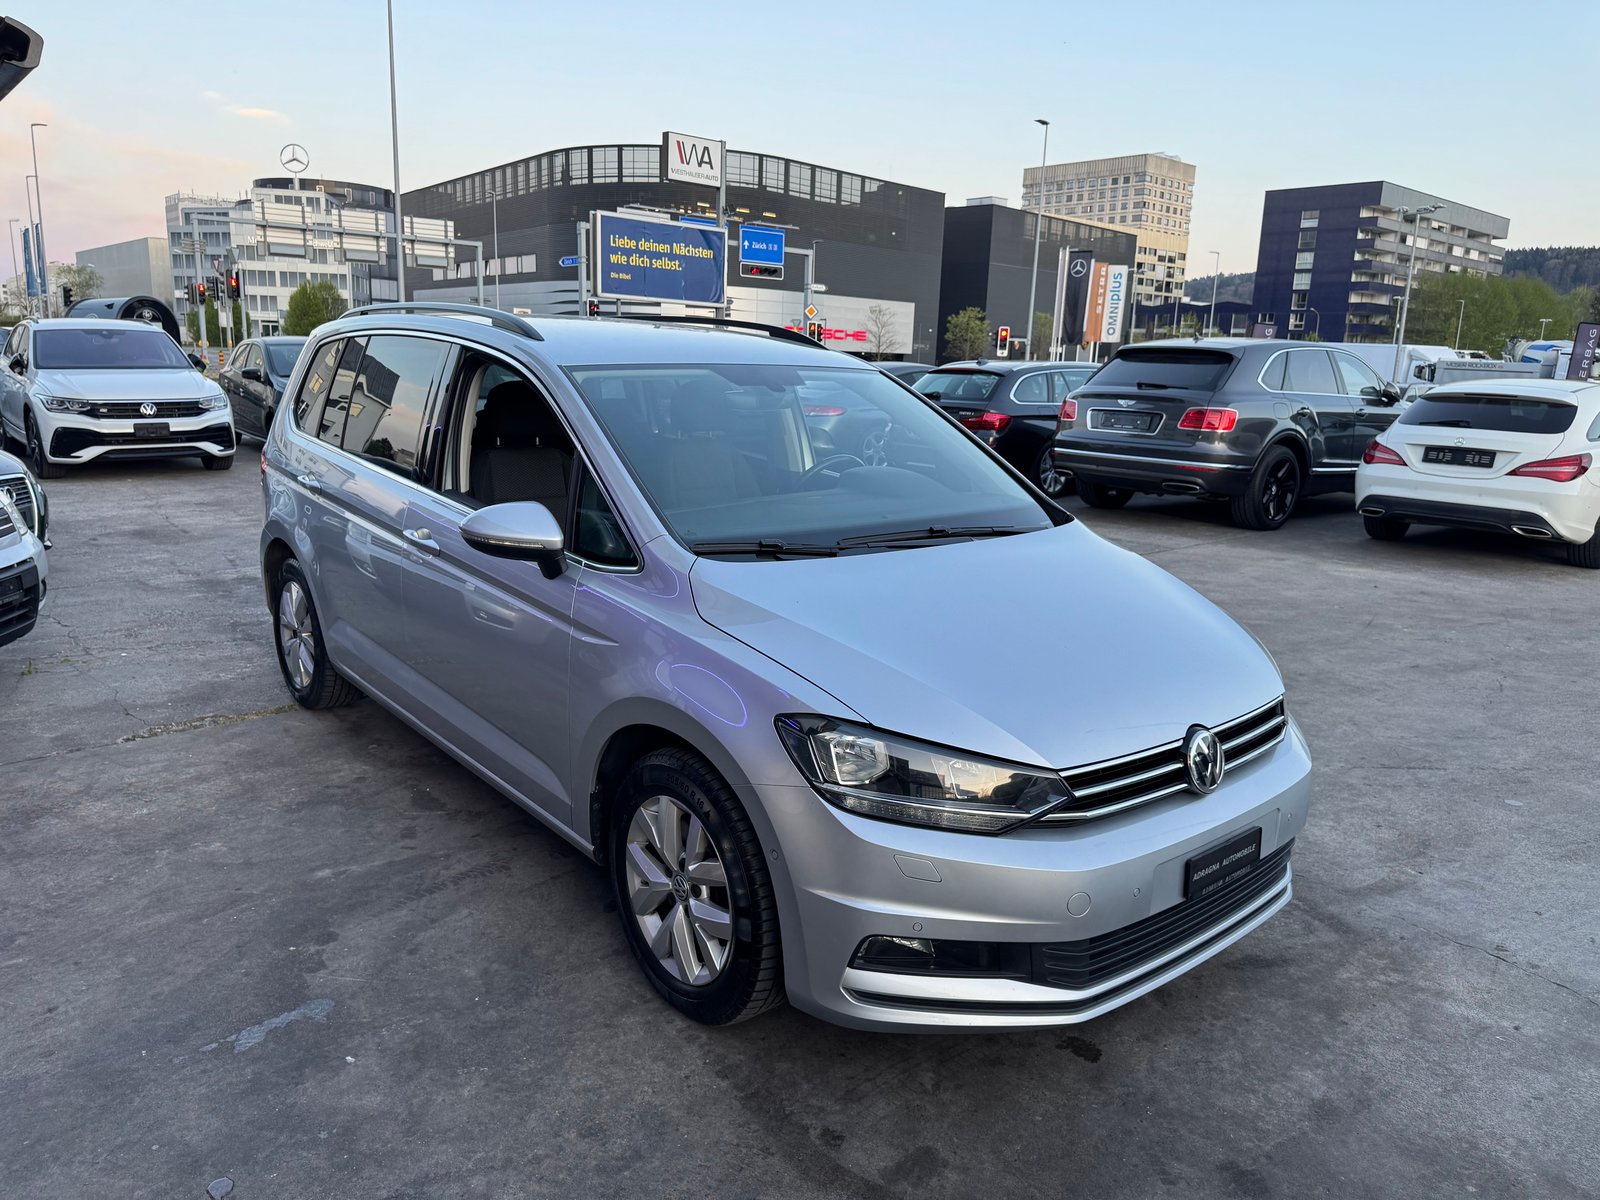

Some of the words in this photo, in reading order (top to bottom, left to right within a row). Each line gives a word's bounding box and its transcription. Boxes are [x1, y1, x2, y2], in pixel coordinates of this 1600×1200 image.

[610, 235, 637, 248] Liebe
[639, 238, 670, 254] deinen
[673, 243, 714, 259] Nächsten
[610, 252, 627, 264] wie
[629, 253, 650, 268] dich
[652, 257, 682, 271] selbst.
[619, 272, 632, 280] Bibel
[1192, 862, 1220, 881] ADRAGNA
[1221, 843, 1256, 867] AUTOMOBILE
